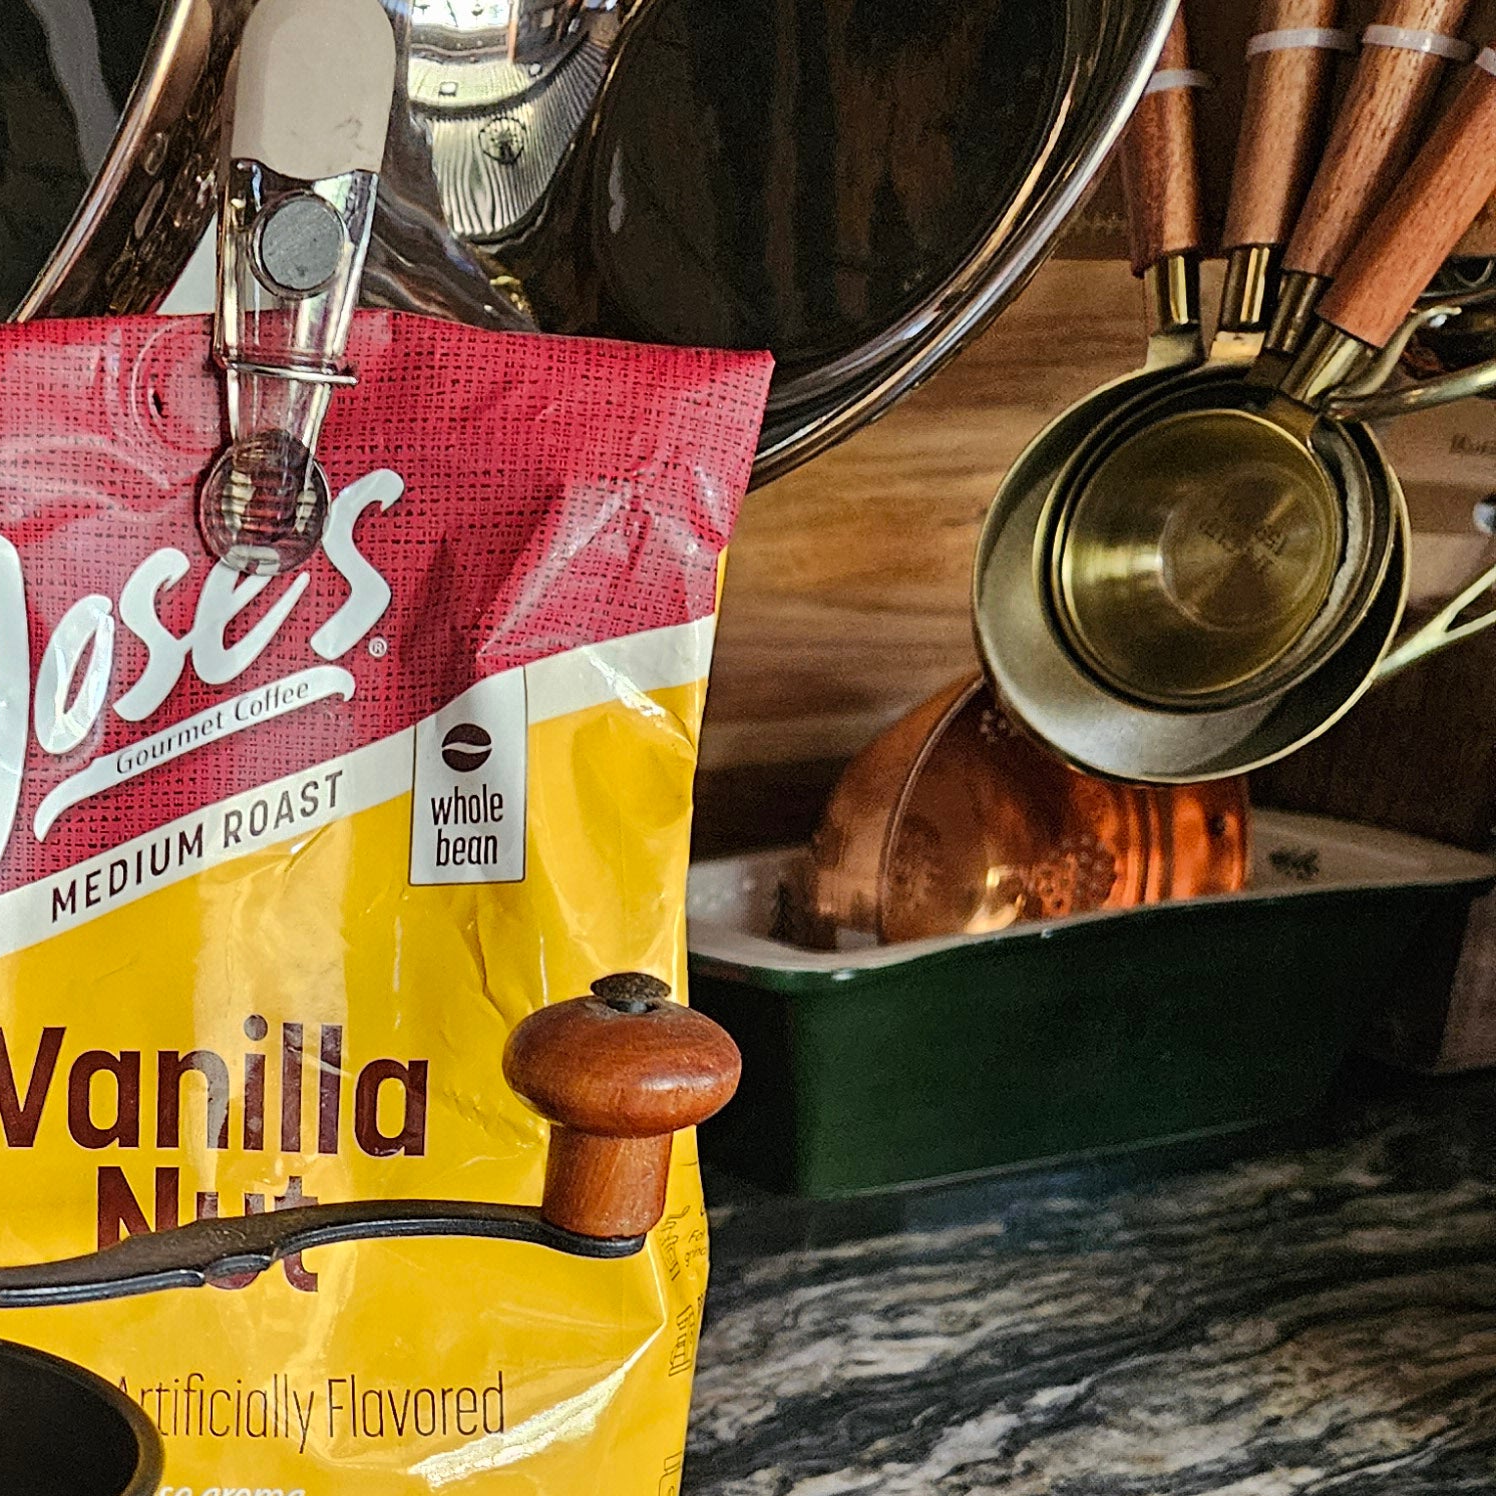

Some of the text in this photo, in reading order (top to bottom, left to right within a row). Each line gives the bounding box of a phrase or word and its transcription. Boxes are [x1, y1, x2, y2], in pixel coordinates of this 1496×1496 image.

[115, 681, 309, 775] Gourmet Coffee
[430, 783, 504, 826] whole
[50, 770, 346, 923] MEDIUM ROAST
[435, 828, 498, 867] bean
[327, 1370, 505, 1438] Flavored
